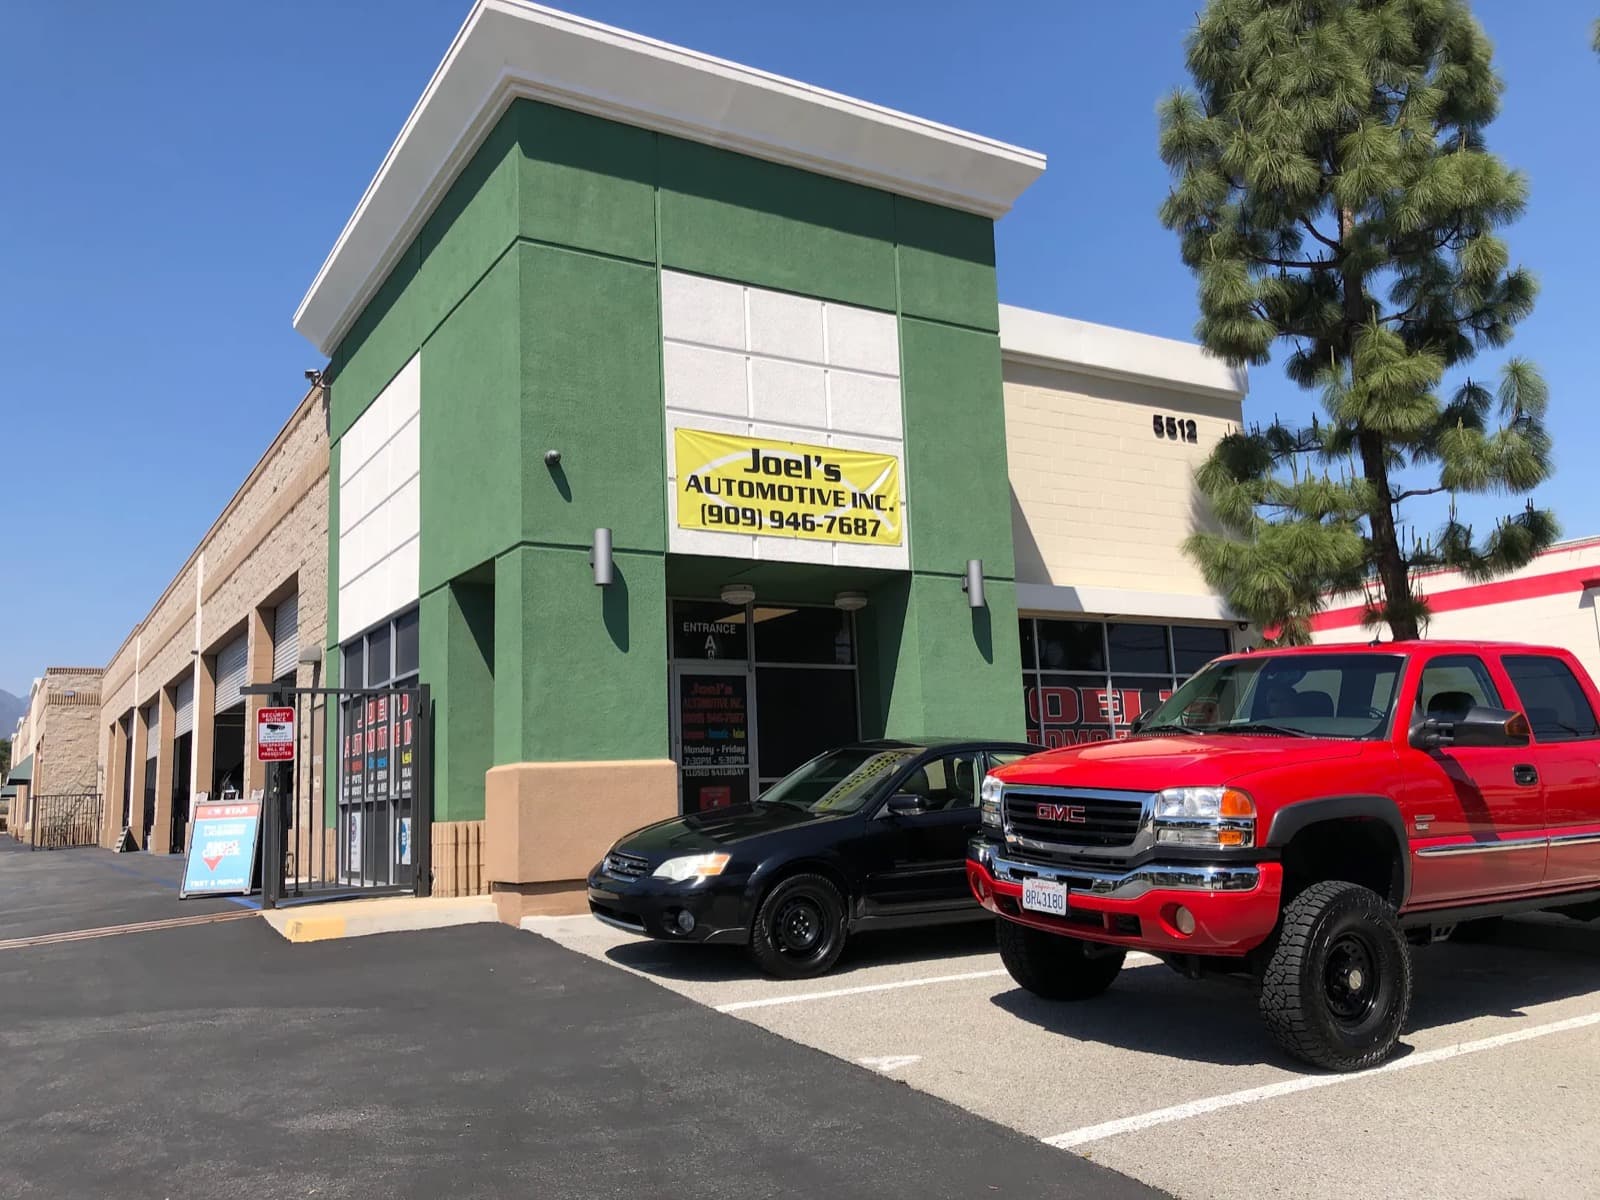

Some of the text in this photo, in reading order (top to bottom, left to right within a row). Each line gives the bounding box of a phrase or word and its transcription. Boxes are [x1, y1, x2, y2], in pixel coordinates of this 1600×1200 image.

[1152, 414, 1198, 444] 5512
[743, 448, 842, 483] Joel's
[684, 474, 895, 512] AUTOMOTIVE INC.
[700, 503, 881, 537] (909) 946-7687
[682, 621, 737, 634] ENTRANCE
[704, 634, 717, 650] A
[683, 744, 714, 756] Monday
[721, 744, 746, 755] Friday
[1036, 803, 1086, 824] GMC
